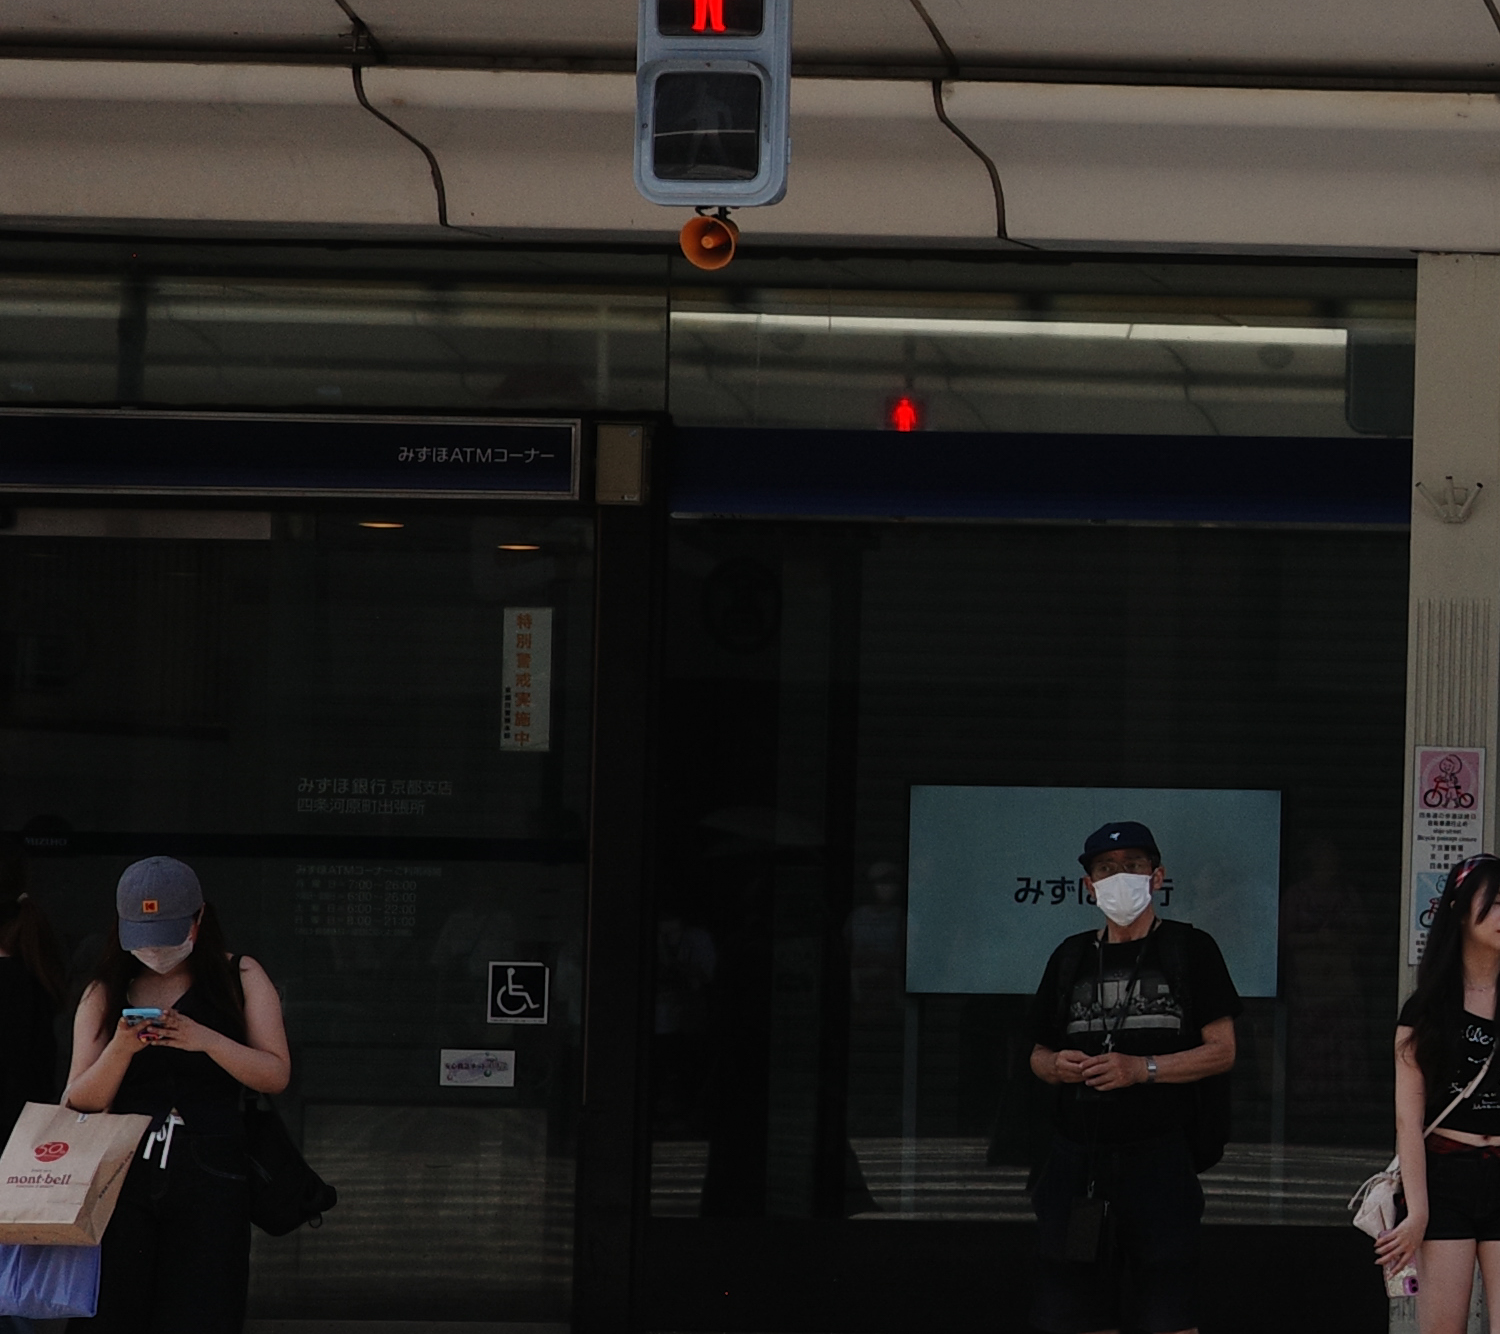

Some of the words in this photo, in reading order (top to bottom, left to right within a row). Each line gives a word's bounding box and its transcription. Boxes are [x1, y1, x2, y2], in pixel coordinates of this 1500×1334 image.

[397, 445, 555, 464] みずほATMコーナー
[1014, 875, 1175, 907] みず行
